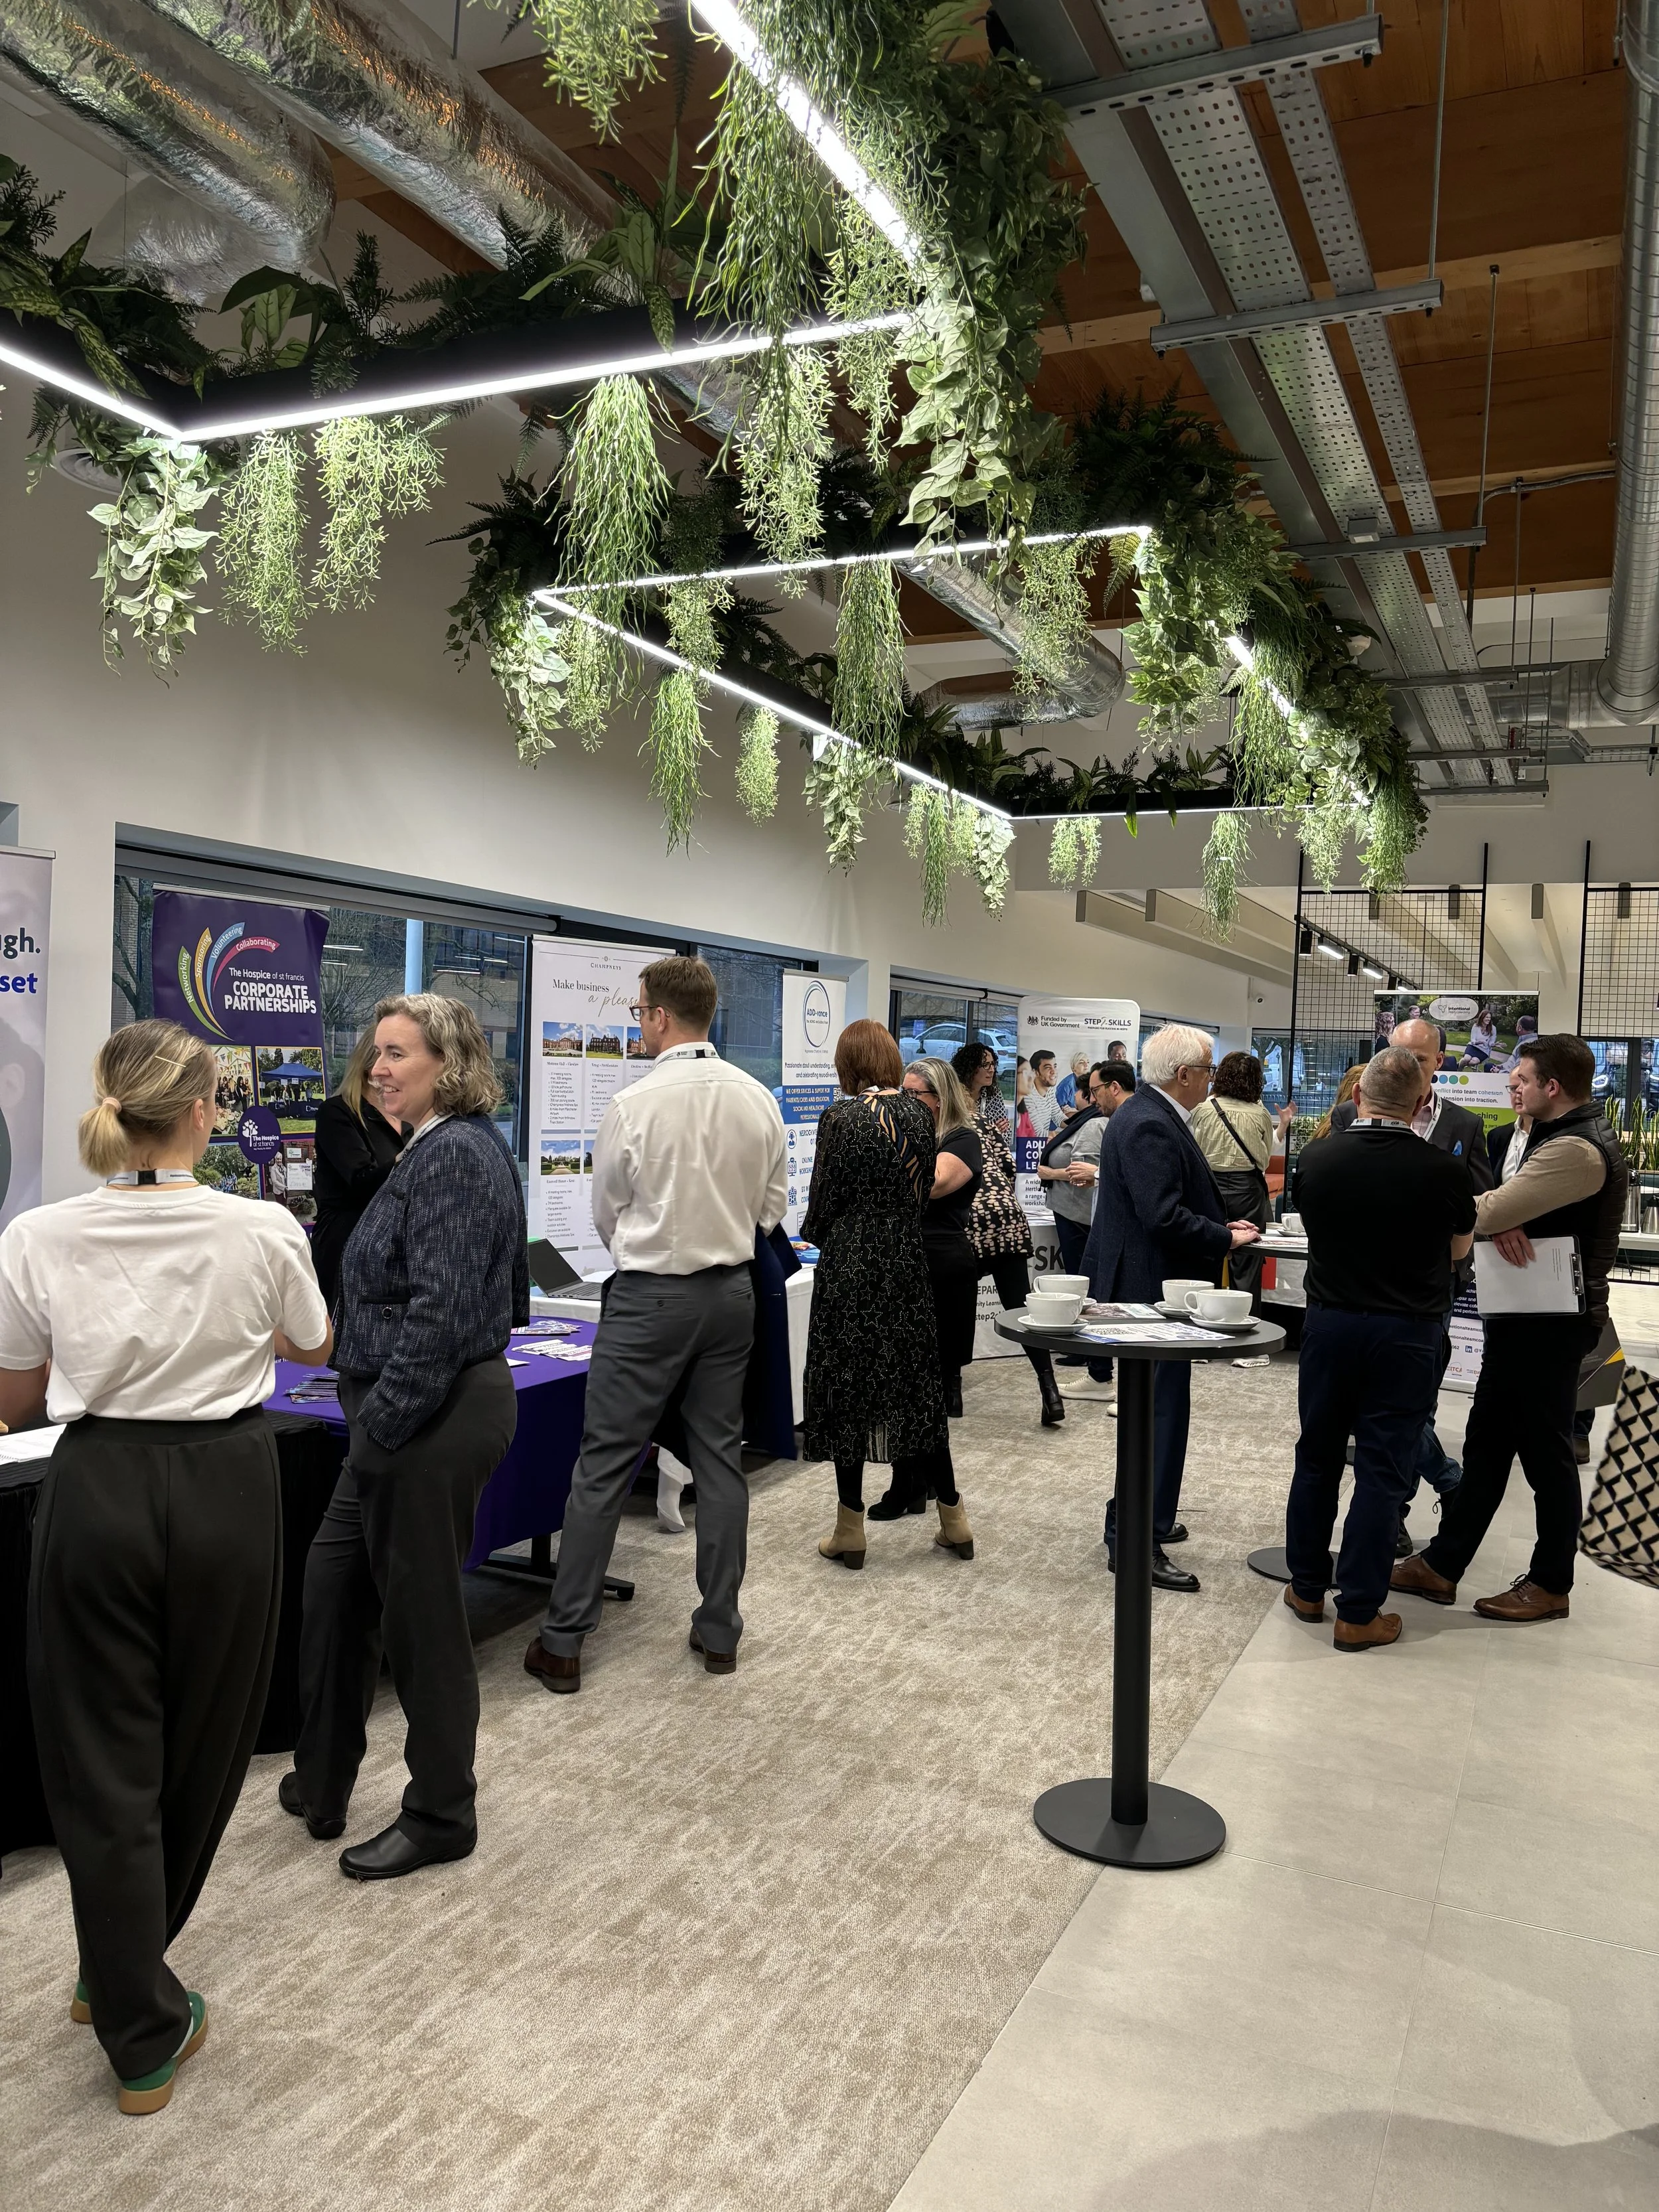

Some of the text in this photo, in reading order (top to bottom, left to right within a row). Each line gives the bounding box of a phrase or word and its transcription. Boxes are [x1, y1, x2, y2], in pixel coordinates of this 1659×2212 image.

[0, 927, 41, 960] gh.
[211, 926, 243, 958] Volunteering
[236, 938, 276, 951] Collaborating
[196, 934, 211, 978] Sponsoring
[180, 952, 193, 1003] Networking
[229, 968, 242, 977] The
[243, 968, 271, 980] Hospice
[285, 971, 305, 982] francis
[233, 981, 309, 999] CORPORATE
[553, 979, 610, 993] Make business
[224, 995, 317, 1014] PARTNERSHIPS
[806, 1008, 828, 1017] ADD-vance
